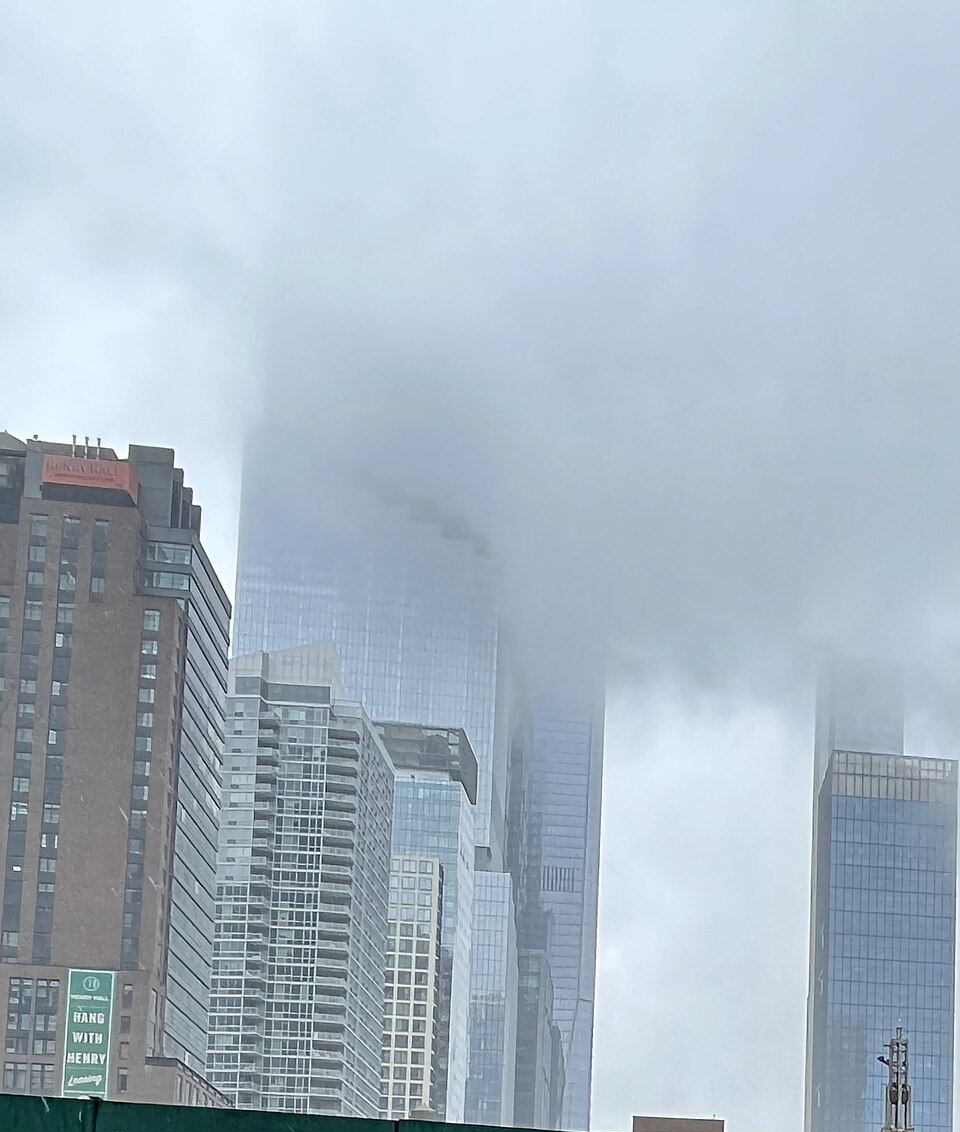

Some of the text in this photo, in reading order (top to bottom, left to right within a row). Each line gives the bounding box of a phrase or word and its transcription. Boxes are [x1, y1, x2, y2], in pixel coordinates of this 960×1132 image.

[73, 1011, 105, 1024] HANG
[72, 1031, 103, 1045] WITH
[66, 1052, 106, 1065] HENRY
